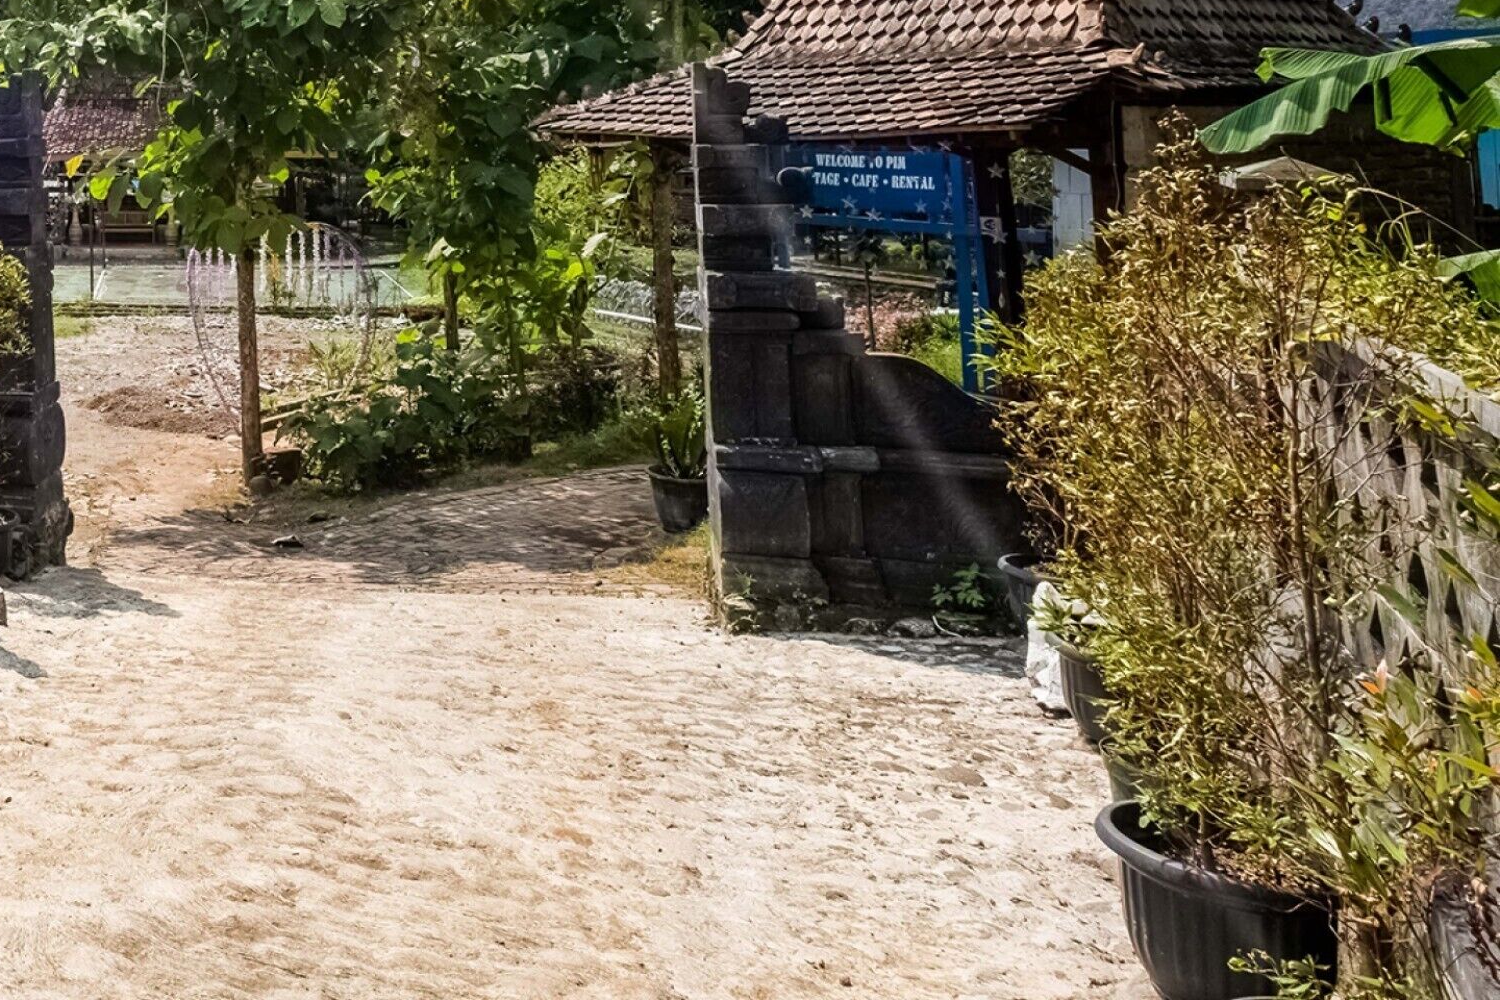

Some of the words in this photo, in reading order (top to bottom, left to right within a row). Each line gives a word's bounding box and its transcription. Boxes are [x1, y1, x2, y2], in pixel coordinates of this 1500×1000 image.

[815, 154, 865, 169] WELCOME
[886, 156, 906, 170] PIM
[812, 172, 840, 186] TAGE
[851, 174, 879, 188] CAFE
[891, 175, 936, 190] RENTAL
